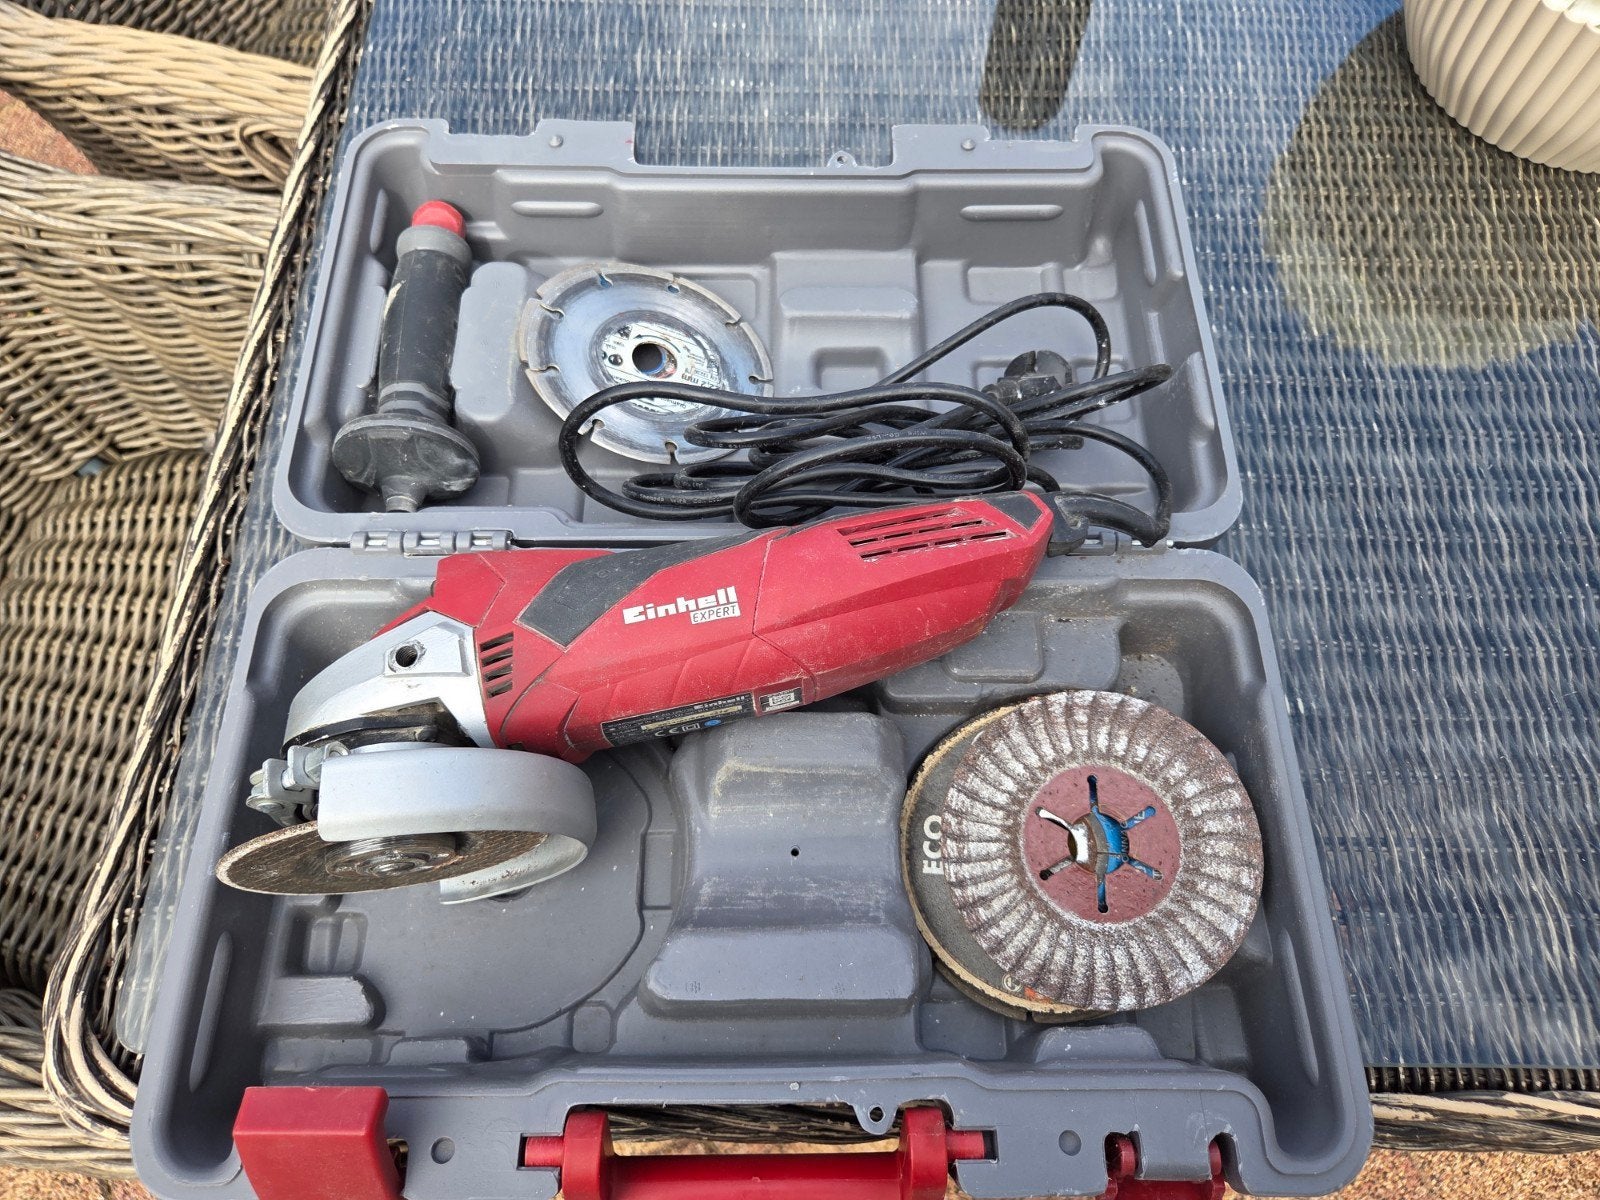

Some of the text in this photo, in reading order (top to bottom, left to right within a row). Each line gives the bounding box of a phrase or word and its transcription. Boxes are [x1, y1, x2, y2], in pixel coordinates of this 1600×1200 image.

[622, 585, 738, 625] Einhell
[691, 603, 739, 624] EXPERT
[922, 814, 944, 875] ECO
